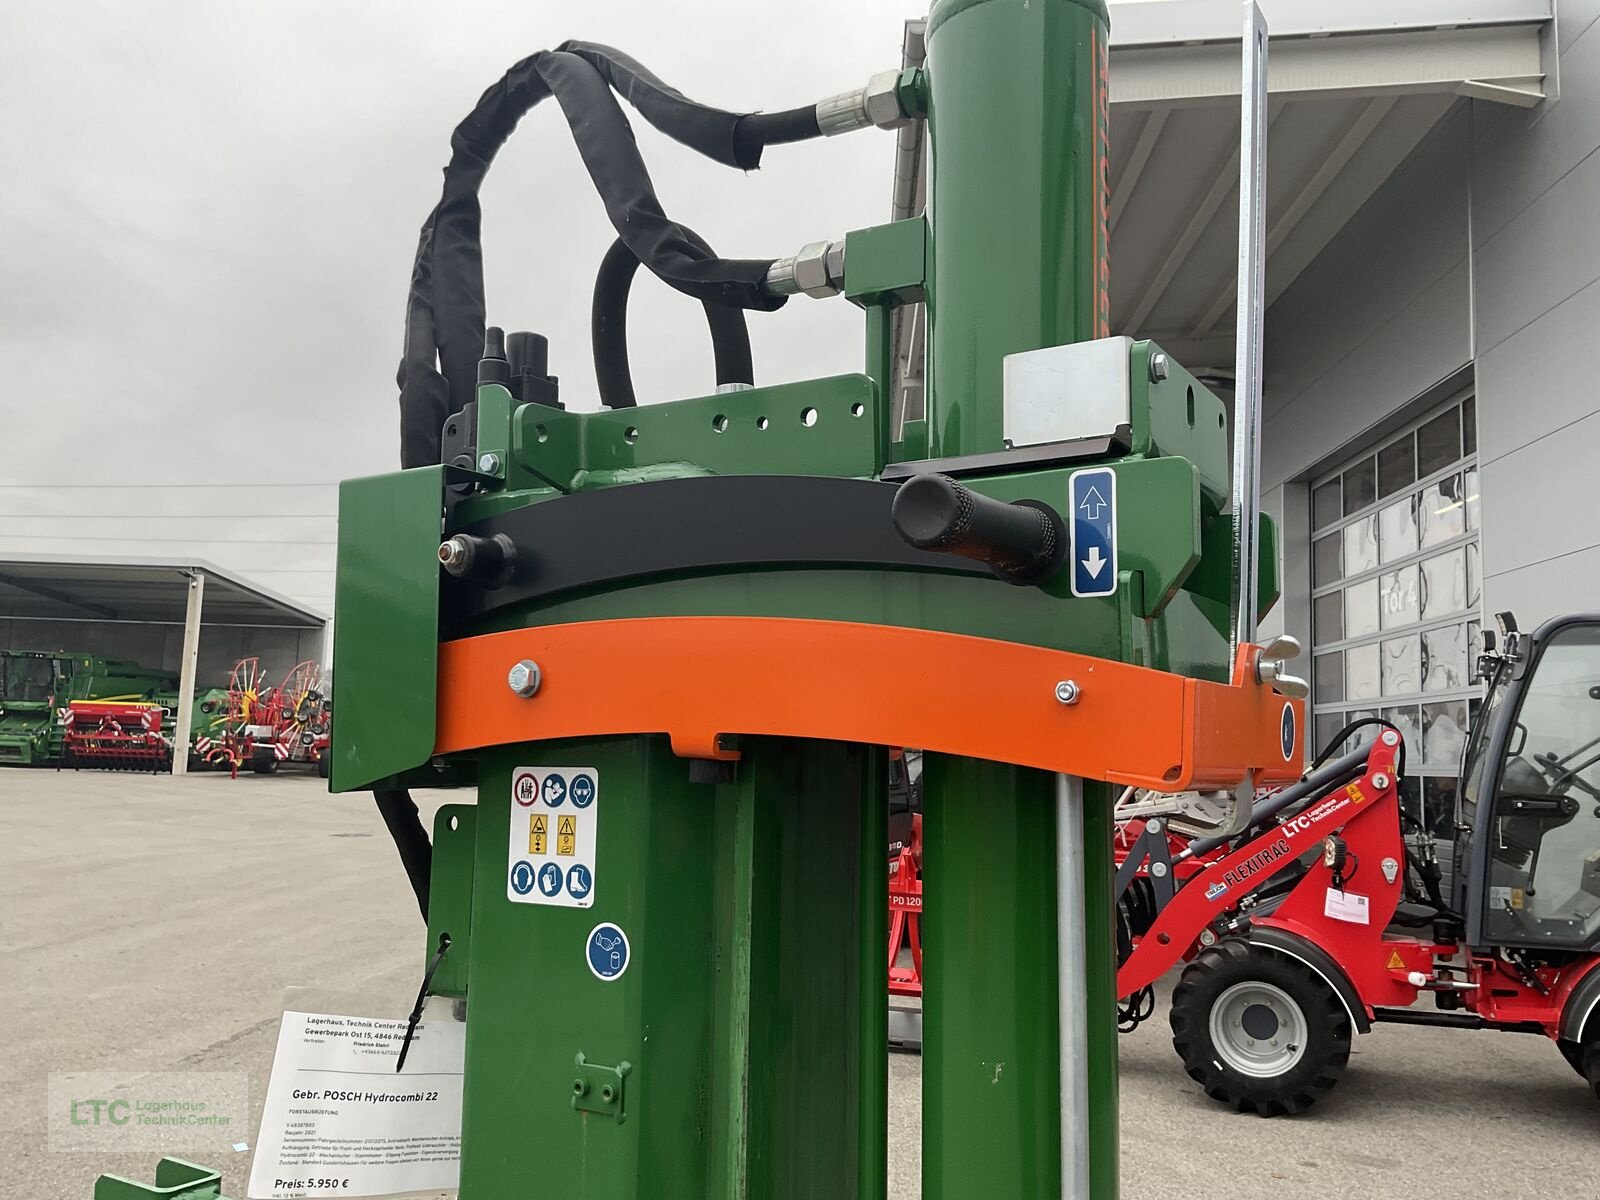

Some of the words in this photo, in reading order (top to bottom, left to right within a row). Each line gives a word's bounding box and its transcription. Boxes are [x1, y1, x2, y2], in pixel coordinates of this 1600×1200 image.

[1381, 588, 1405, 614] Tor
[1306, 798, 1337, 818] Lagerhaus
[1311, 798, 1350, 824] TechnikCenter
[1281, 815, 1311, 839] LTC
[1224, 839, 1291, 888] FLEXITRAC
[893, 896, 904, 905] PD
[307, 1016, 345, 1027] Lagerhaus,
[346, 1019, 372, 1028] Technik
[374, 1021, 397, 1030] Center
[304, 1027, 349, 1038] Gewerbepark
[351, 1030, 362, 1038] Ost
[363, 1031, 373, 1040] 15,
[374, 1032, 392, 1040] 4846
[292, 1089, 320, 1100] Gebr.
[323, 1090, 362, 1102] POSCH
[364, 1092, 424, 1104] Hydrocombi
[425, 1092, 438, 1101] 22
[274, 1178, 305, 1189] Preis:
[306, 1178, 339, 1189] 5.950
[341, 1178, 350, 1188] €
